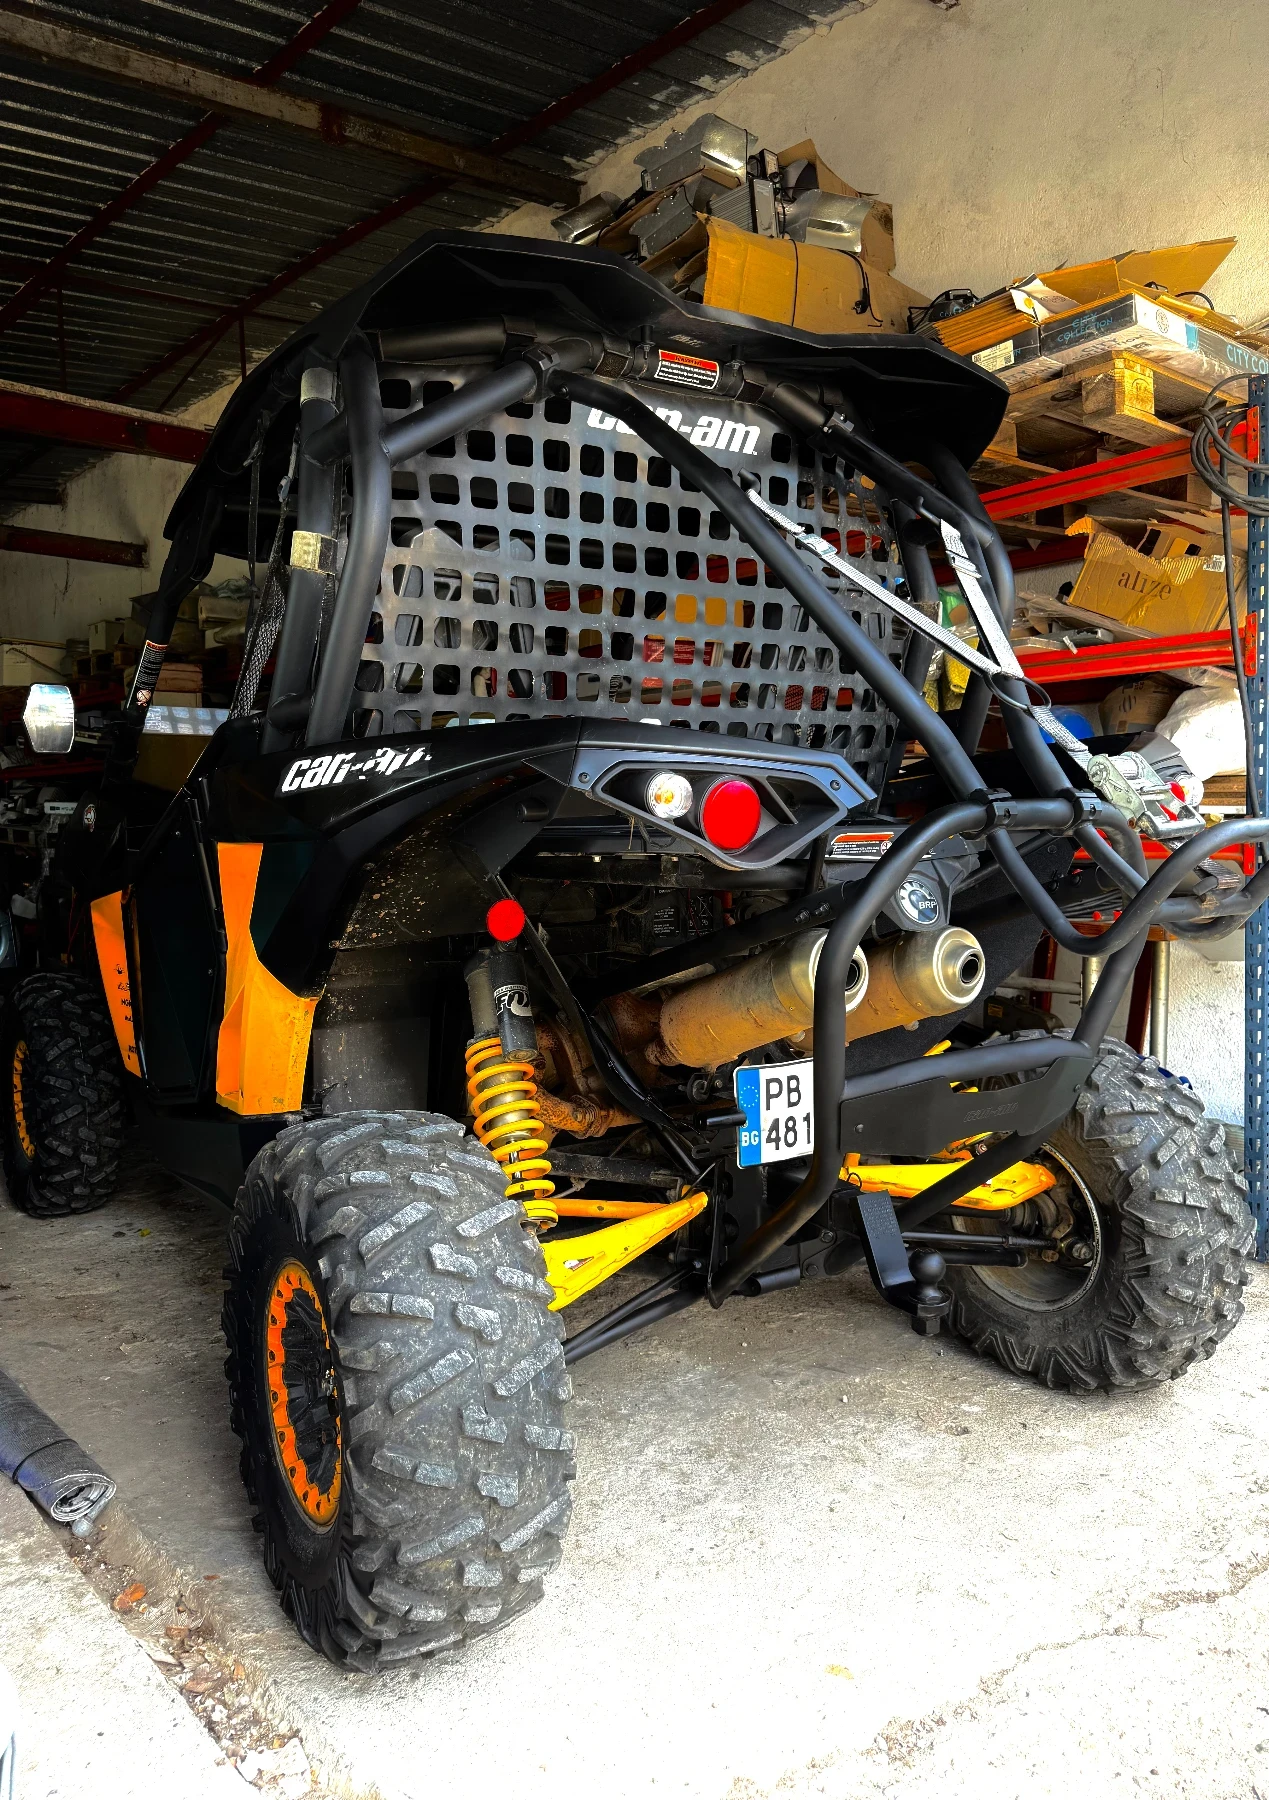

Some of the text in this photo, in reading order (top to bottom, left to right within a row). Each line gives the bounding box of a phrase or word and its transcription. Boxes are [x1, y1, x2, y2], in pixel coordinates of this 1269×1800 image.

[1226, 344, 1250, 369] CITY
[1117, 569, 1172, 600] alize
[918, 900, 938, 910] BRP
[765, 1074, 801, 1111] PB
[741, 1130, 759, 1147] BG
[765, 1111, 811, 1150] 481
